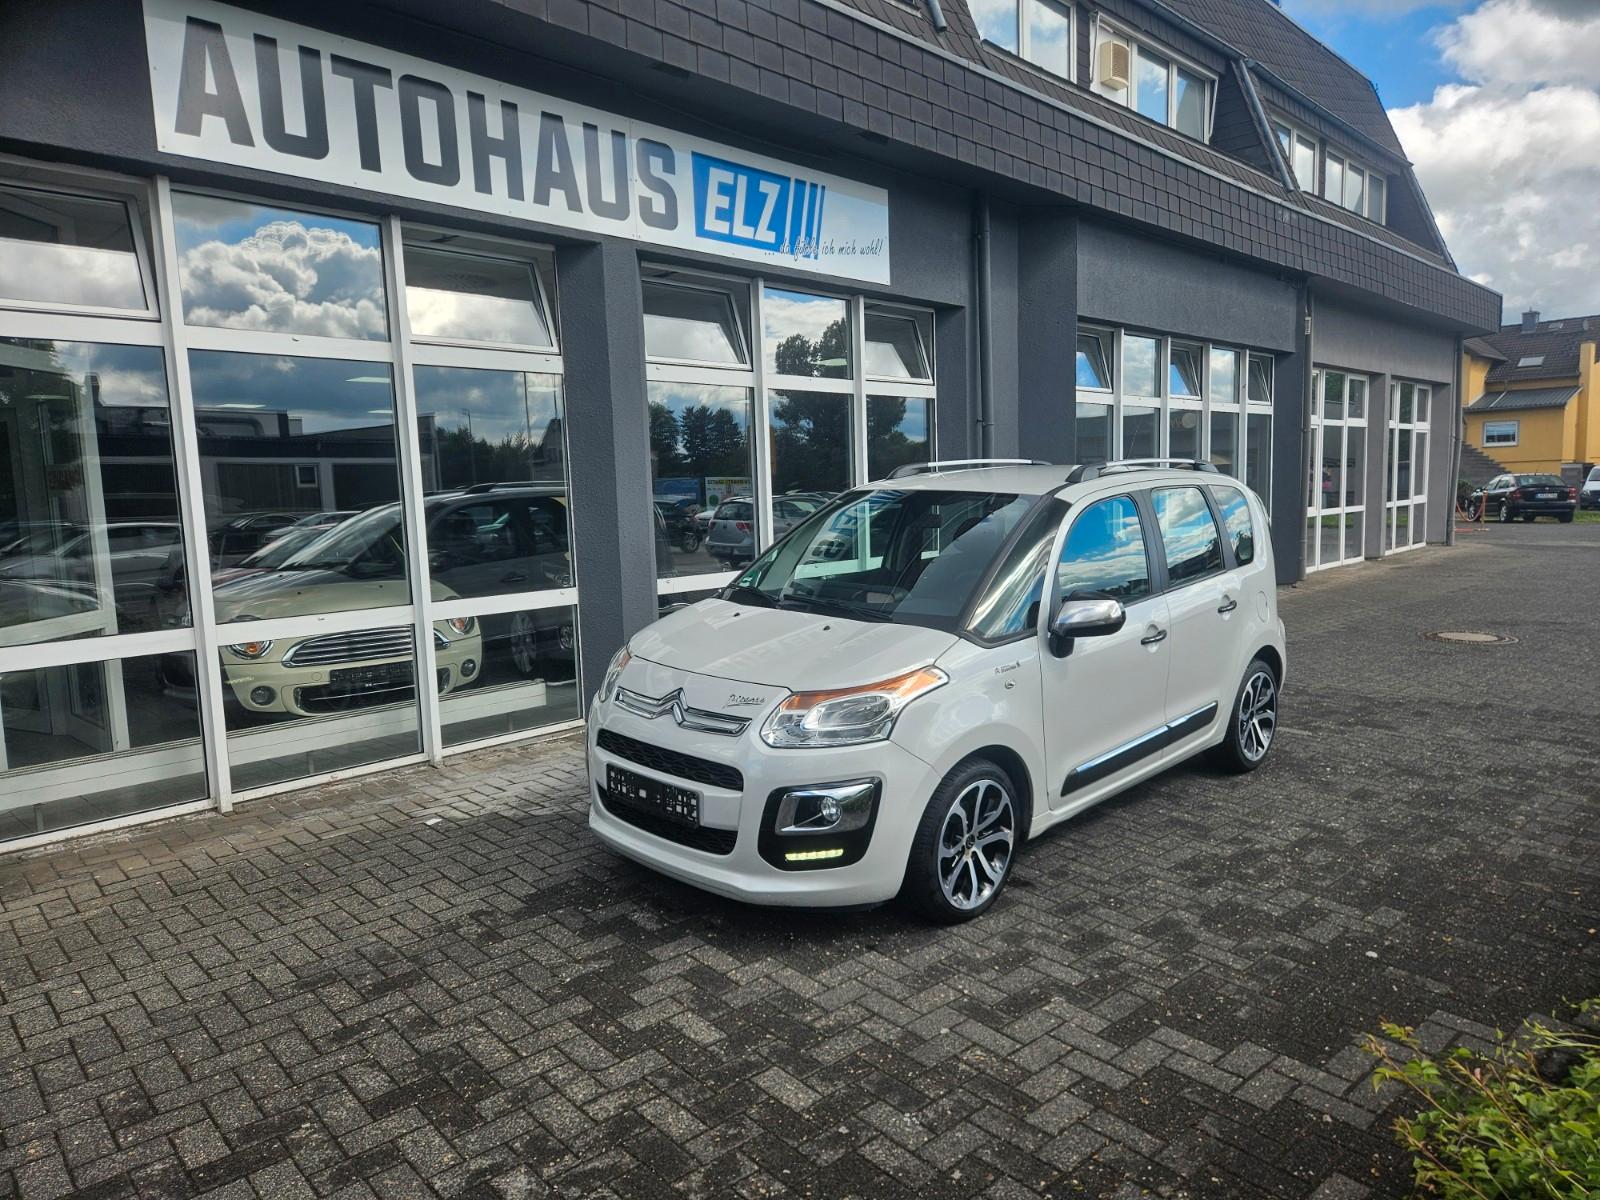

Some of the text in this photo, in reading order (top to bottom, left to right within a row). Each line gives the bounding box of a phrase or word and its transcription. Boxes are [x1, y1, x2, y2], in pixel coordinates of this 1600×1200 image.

[174, 15, 781, 243] AUTOHAUS ELZ
[821, 238, 836, 256] ich
[837, 239, 857, 256] mich
